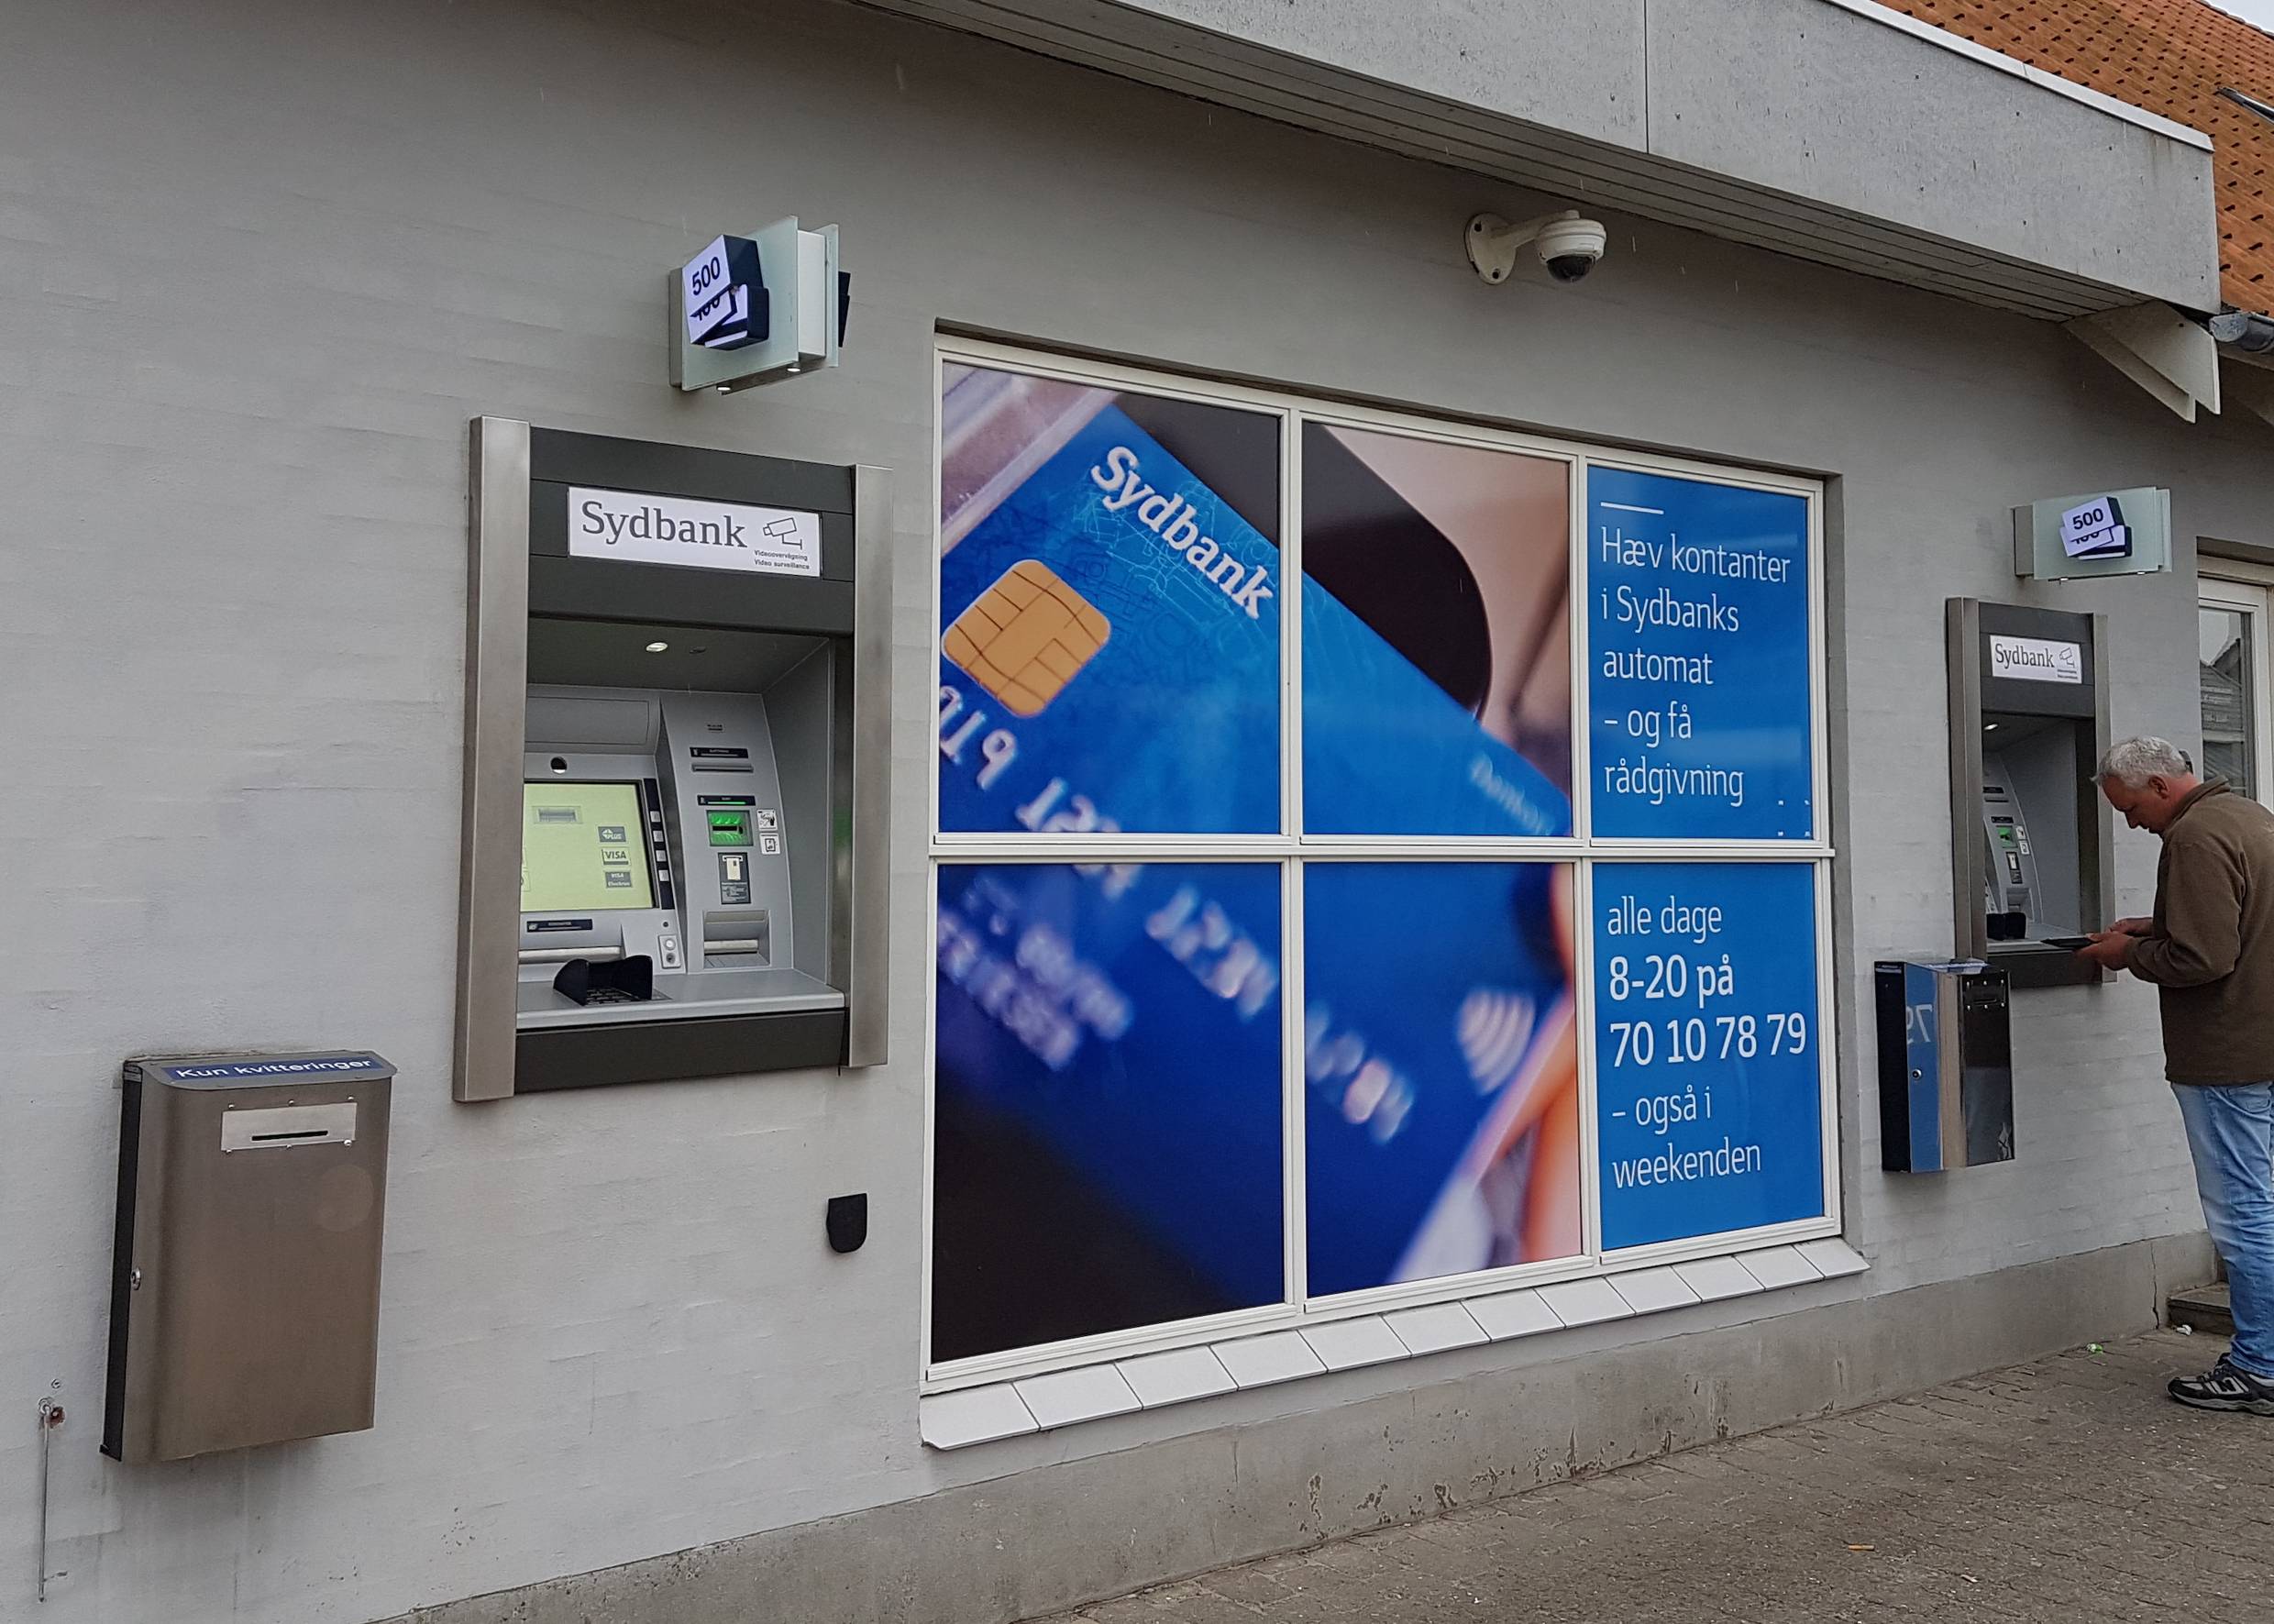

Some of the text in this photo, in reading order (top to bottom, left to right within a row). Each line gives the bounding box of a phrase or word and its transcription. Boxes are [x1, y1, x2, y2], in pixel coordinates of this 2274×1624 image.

[691, 256, 721, 296] 500
[580, 501, 748, 548] Sydbank
[1089, 445, 1275, 620] Sydbank
[2071, 507, 2104, 531] 500
[1601, 526, 1791, 583] Hæv kontanter
[1601, 585, 1739, 634] i Sydbanks
[1603, 647, 1714, 685] automat
[1994, 642, 2056, 669] Sydbank
[1628, 709, 1661, 748] og
[1667, 700, 1692, 739] få
[1605, 756, 1744, 807] rådgivning
[604, 850, 627, 859] VISA
[1607, 895, 1722, 944] alle dage
[1609, 954, 1734, 1009] 8-20 på
[1610, 1012, 1806, 1067] 70 10 78 79
[175, 1057, 372, 1079] Kun kvitteringer
[1636, 1084, 1696, 1135] også
[1705, 1086, 1711, 1119] i
[1612, 1136, 1761, 1188] weekenden
